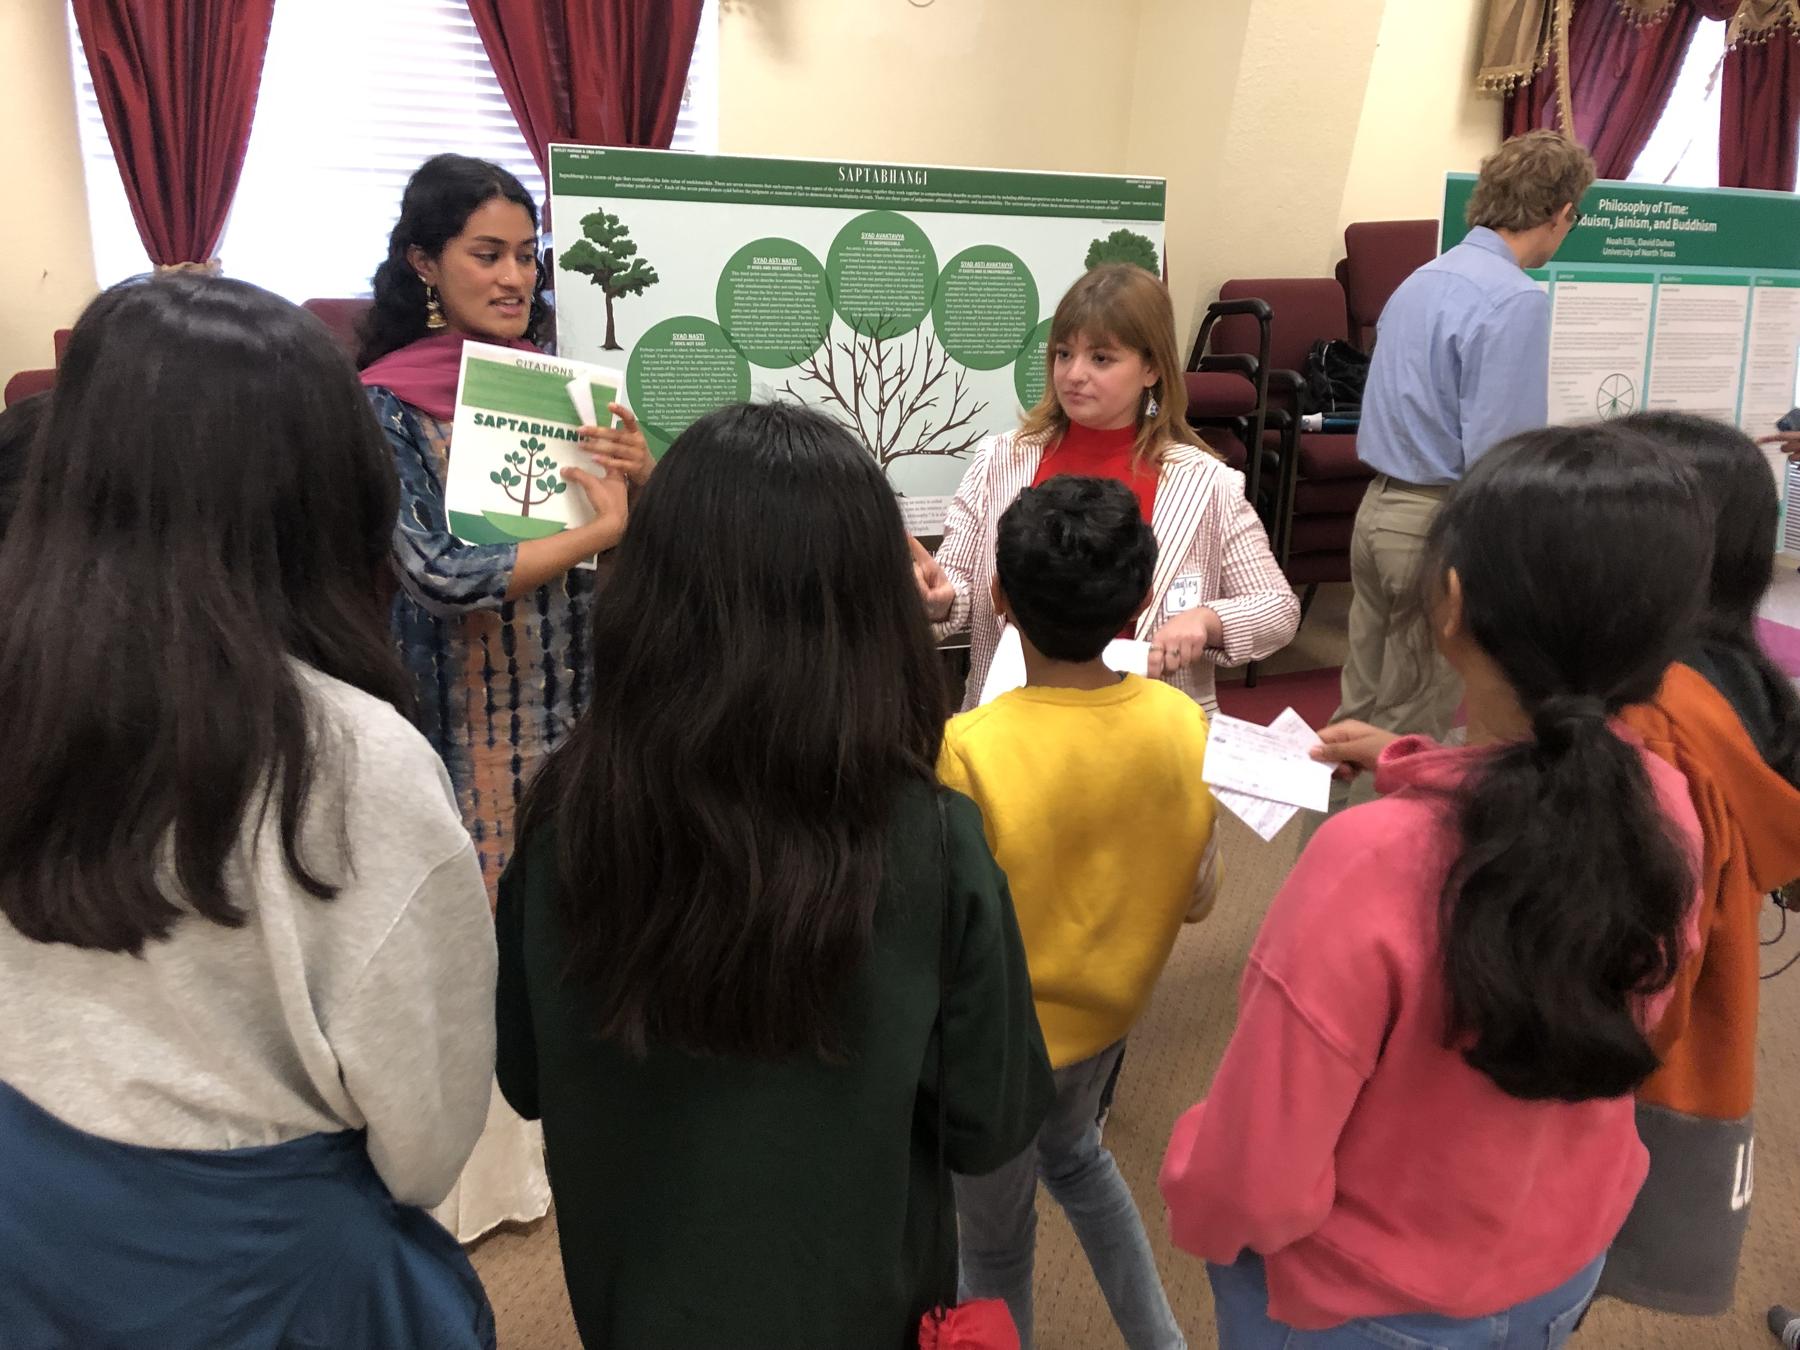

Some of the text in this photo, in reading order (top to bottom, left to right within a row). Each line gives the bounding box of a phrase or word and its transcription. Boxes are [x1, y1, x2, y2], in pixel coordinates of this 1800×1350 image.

[838, 166, 928, 186] SAPTABHANGI
[1599, 198, 1688, 216] Philosophy of Time:
[1578, 214, 1717, 232] duism, Jainism, and Buddhism
[1602, 248, 1633, 257] University
[1660, 249, 1676, 257] Texas
[516, 358, 574, 377] CITATIONS
[474, 413, 587, 443] SAPTABHAN
